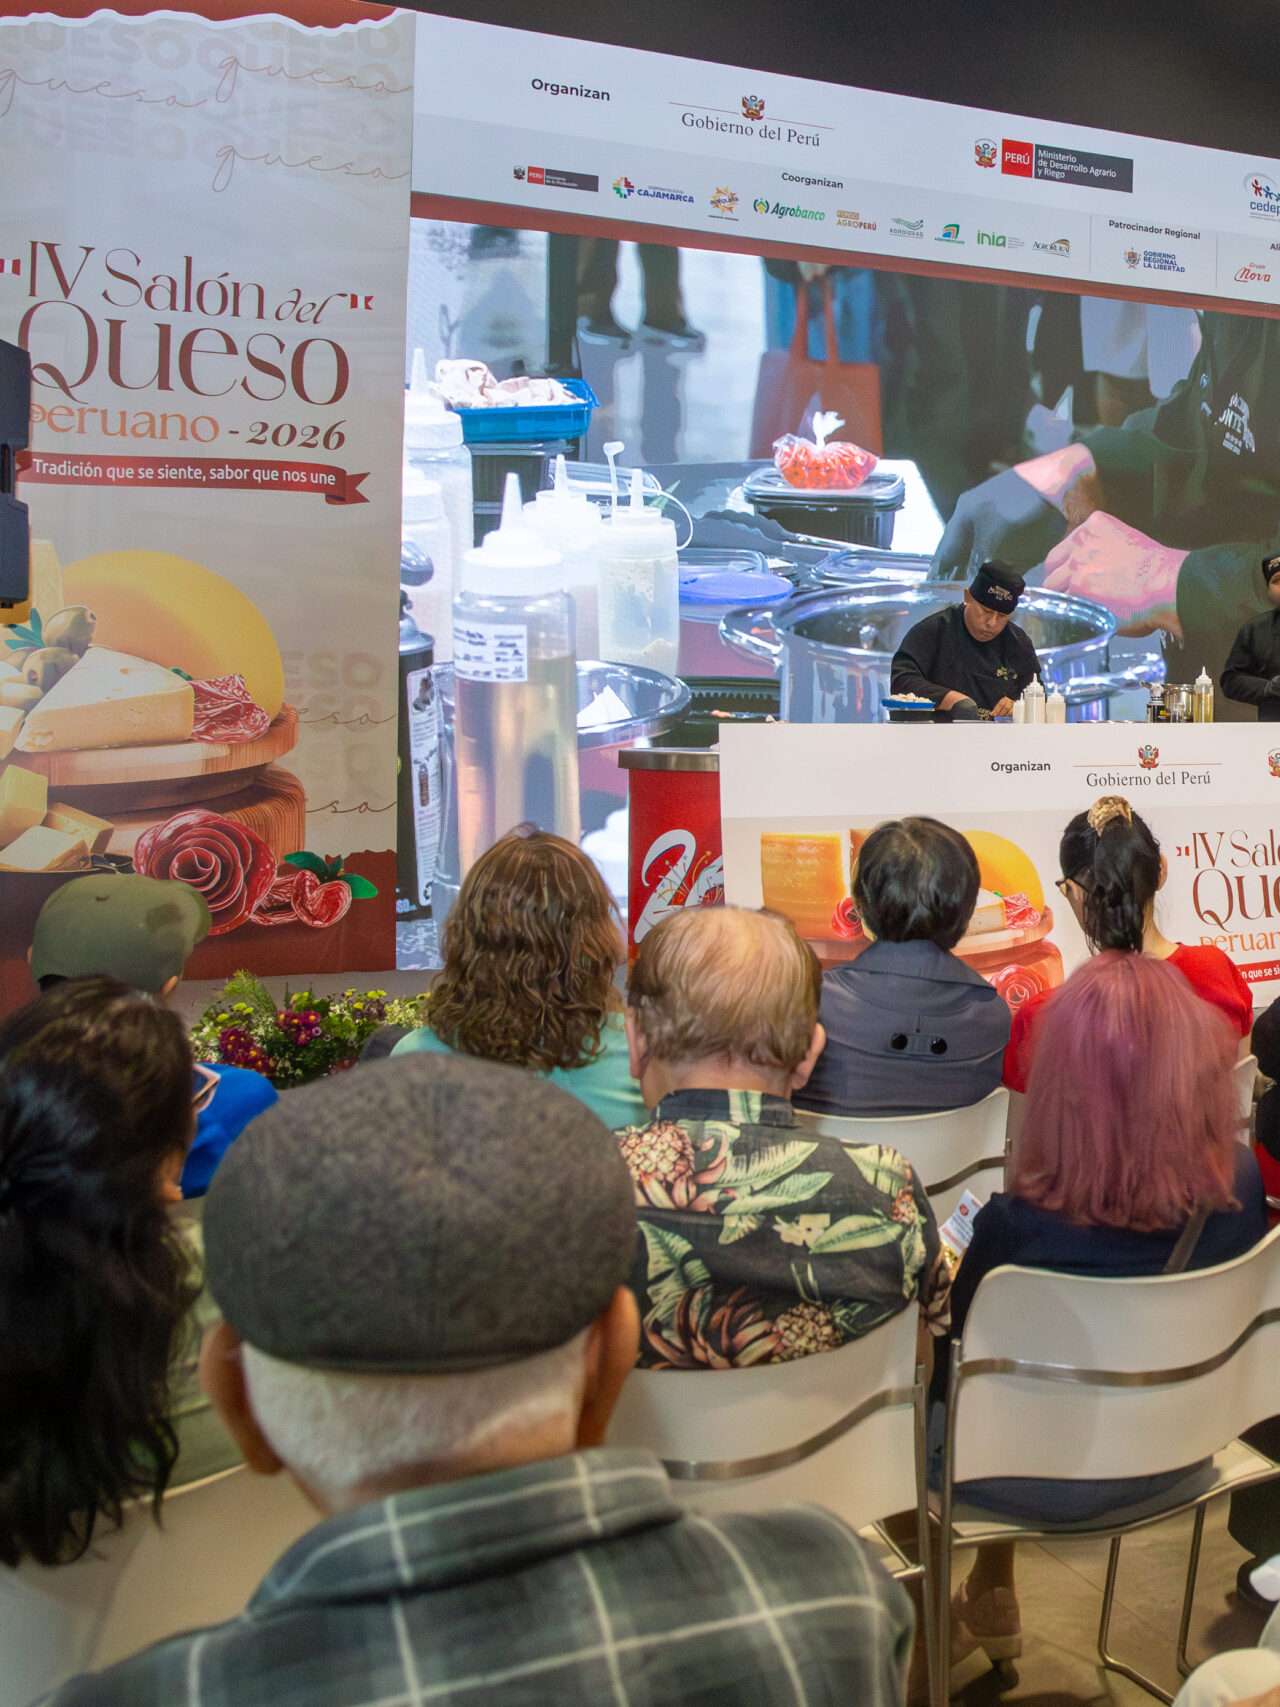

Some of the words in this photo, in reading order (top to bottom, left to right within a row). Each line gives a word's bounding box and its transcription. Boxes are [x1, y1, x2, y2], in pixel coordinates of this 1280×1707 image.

[531, 77, 611, 102] Organizan
[681, 112, 754, 139] Gobierno
[758, 125, 782, 142] del
[786, 127, 821, 148] Perú
[1004, 152, 1030, 166] PERÚ
[1038, 149, 1078, 163] Ministerio
[1037, 168, 1042, 177] y
[1044, 168, 1066, 180] Riego
[1038, 159, 1048, 167] de
[1050, 160, 1088, 174] Desarrollo
[1089, 166, 1117, 179] Agrario
[781, 172, 844, 190] Coorganizan
[636, 188, 695, 204] CAJAMARCA
[770, 202, 826, 221] Agrobanco
[977, 230, 1007, 248] inia
[1108, 220, 1162, 235] Patrocinador
[1164, 227, 1200, 240] Regional
[28, 240, 95, 300] IV
[102, 248, 265, 320] Salón
[273, 286, 346, 326] del
[17, 300, 350, 406] Queso
[246, 420, 346, 451] 2026
[32, 457, 102, 478] Tradición
[106, 465, 134, 482] que
[137, 468, 154, 480] se
[157, 464, 206, 483] siente,
[209, 464, 251, 482] sabor
[253, 468, 279, 487] que
[281, 469, 307, 484] nos
[309, 471, 336, 486] une
[990, 760, 1051, 775] Organizan
[1086, 772, 1151, 788] Gobierno
[1155, 771, 1176, 785] del
[1181, 770, 1211, 785] Perú
[1192, 832, 1224, 869] IV
[1247, 967, 1263, 980] que
[1263, 967, 1272, 977] se
